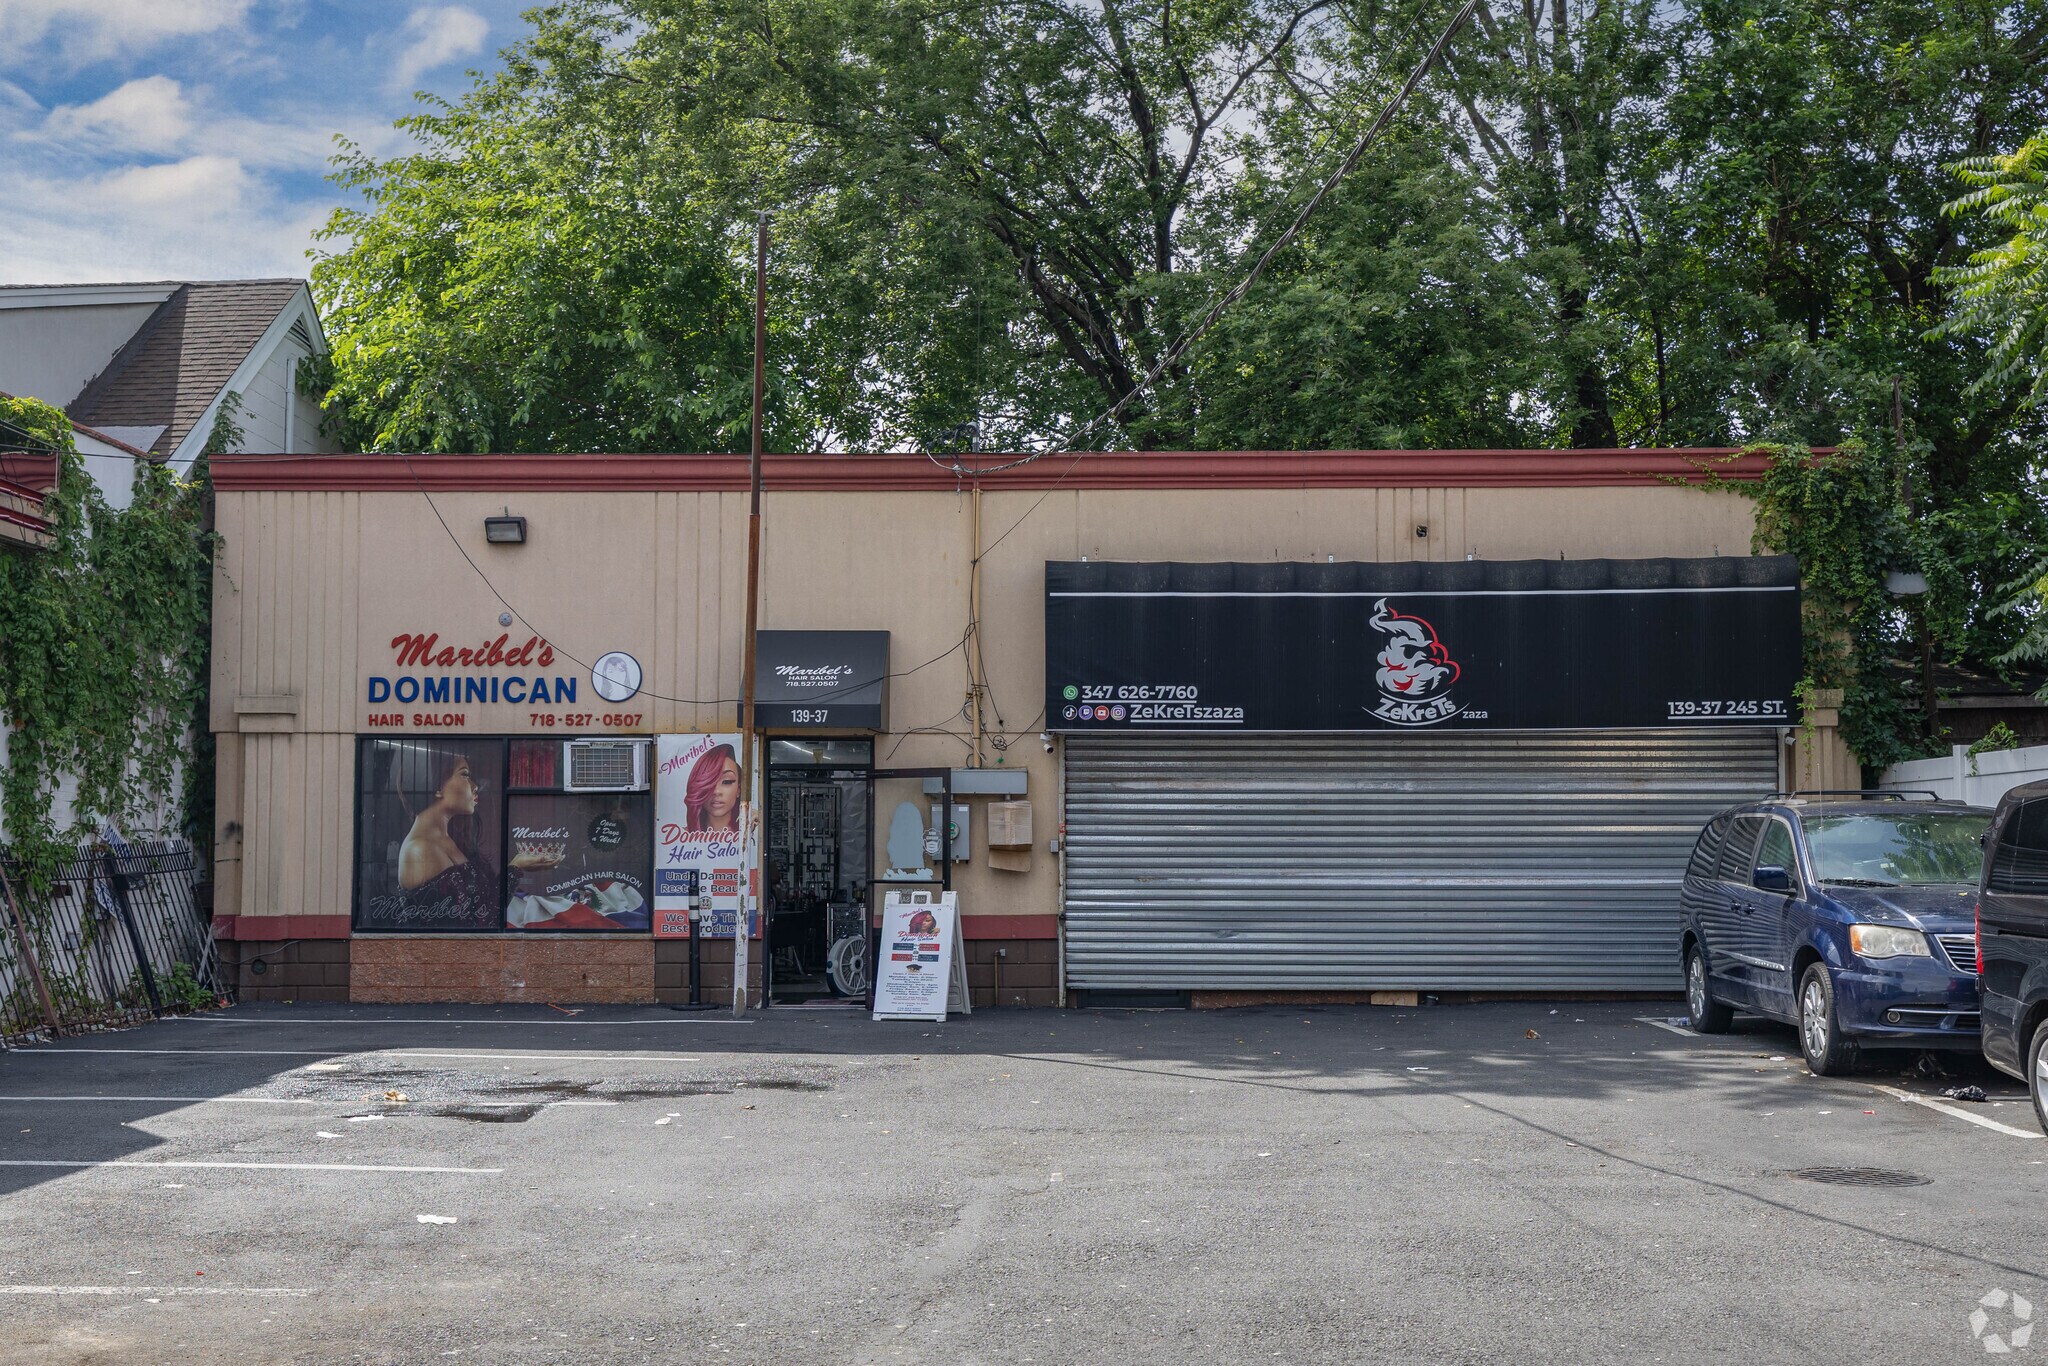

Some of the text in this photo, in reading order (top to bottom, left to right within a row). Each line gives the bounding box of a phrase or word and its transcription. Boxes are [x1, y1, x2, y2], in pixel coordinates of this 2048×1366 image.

[391, 633, 555, 667] Maribel's
[775, 665, 853, 676] Maribel's
[368, 676, 577, 703] DOMINICAN
[1082, 685, 1198, 699] 347 626-7760
[1130, 704, 1244, 719] ZeKreTszaza
[1374, 697, 1488, 721] ZeKreTs zaza
[1668, 700, 1787, 715] 139-37 245 ST.
[368, 714, 465, 726] HAIR SALON
[791, 709, 828, 722] 139-37
[600, 819, 617, 827] Open
[512, 827, 570, 838] Maribel's
[602, 827, 619, 836] Days
[666, 842, 739, 864] Hair Salo
[546, 871, 643, 893] DOMINICAN HAIR SALON
[661, 883, 707, 894] Reste
[369, 895, 489, 919] Maribel's
[665, 913, 684, 923] We
[721, 912, 737, 923] Th
[662, 924, 688, 933] Best
